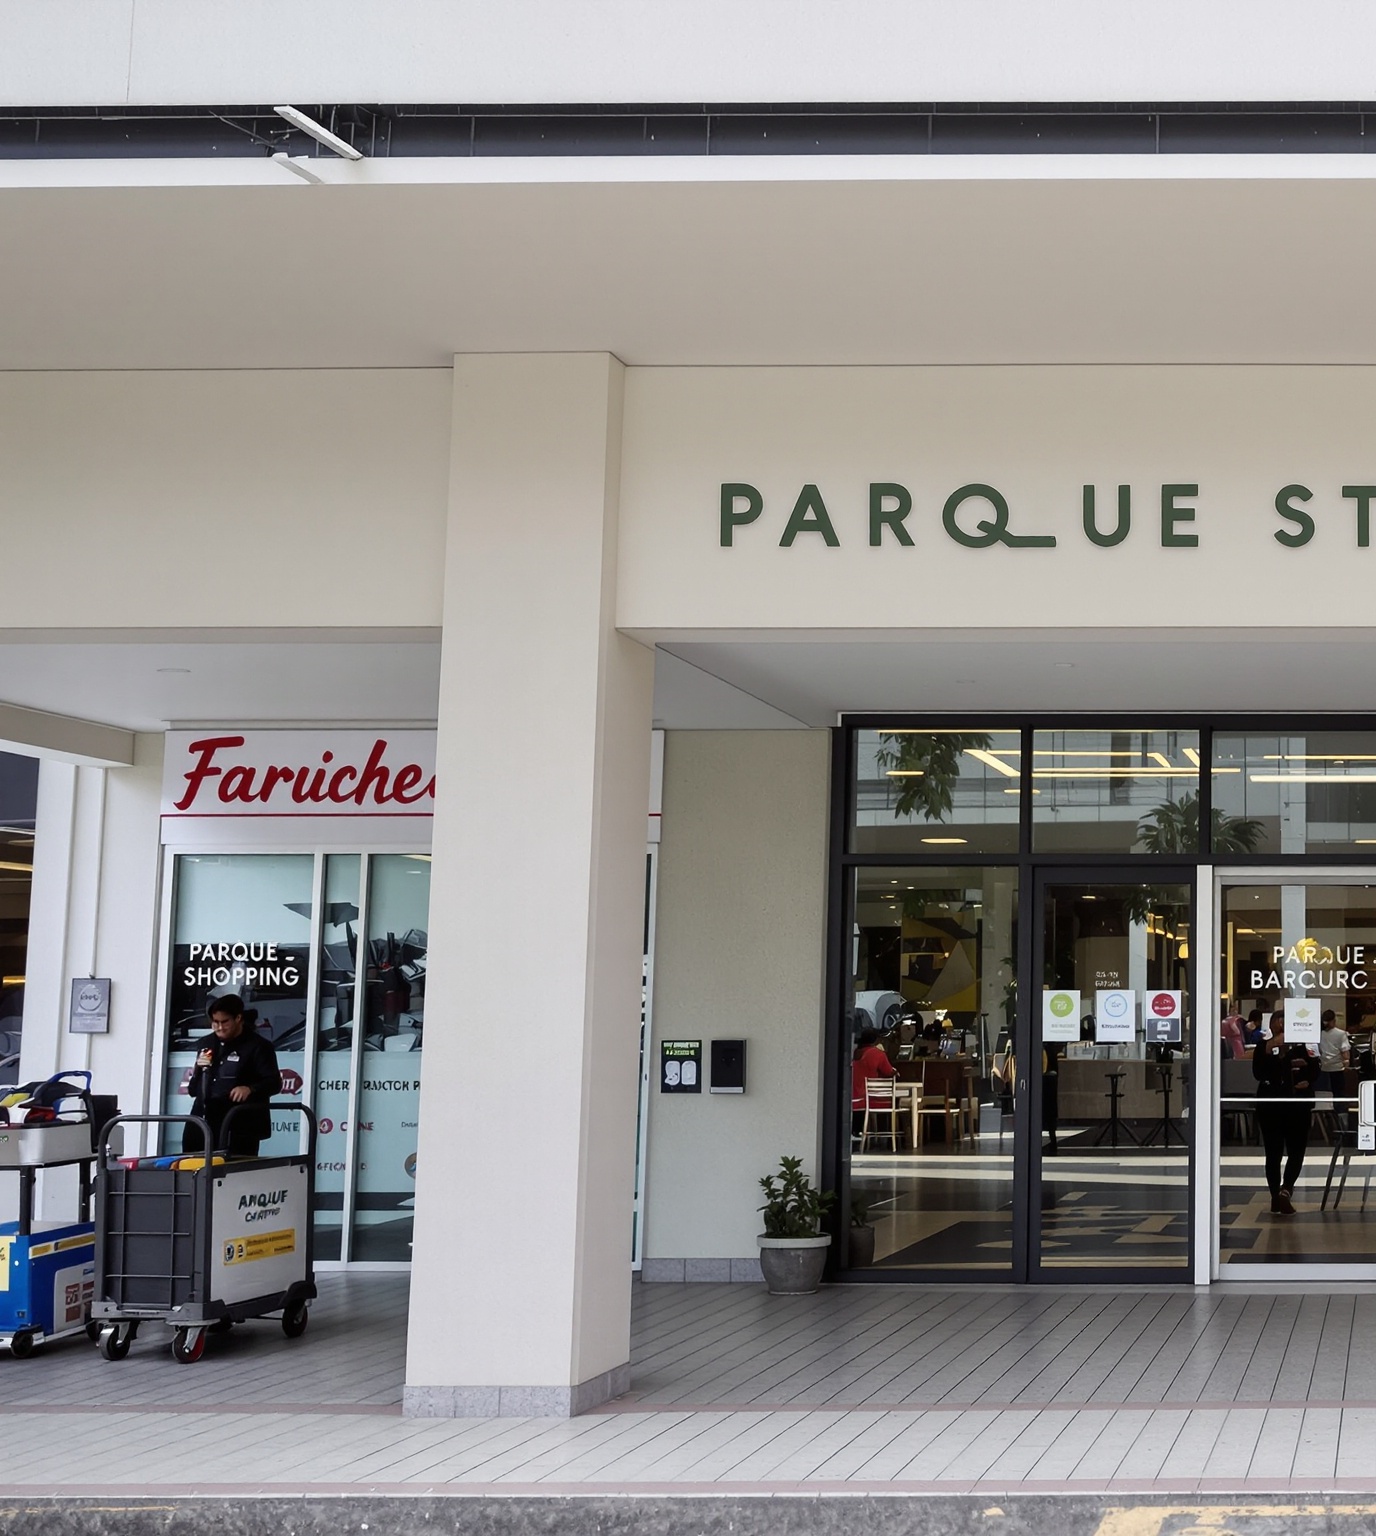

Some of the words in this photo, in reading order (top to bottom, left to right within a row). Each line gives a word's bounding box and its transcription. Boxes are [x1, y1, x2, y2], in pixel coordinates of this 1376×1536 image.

[720, 483, 1199, 548] PARQUE
[189, 940, 279, 962] PARQUE
[183, 966, 300, 986] SHOPPING
